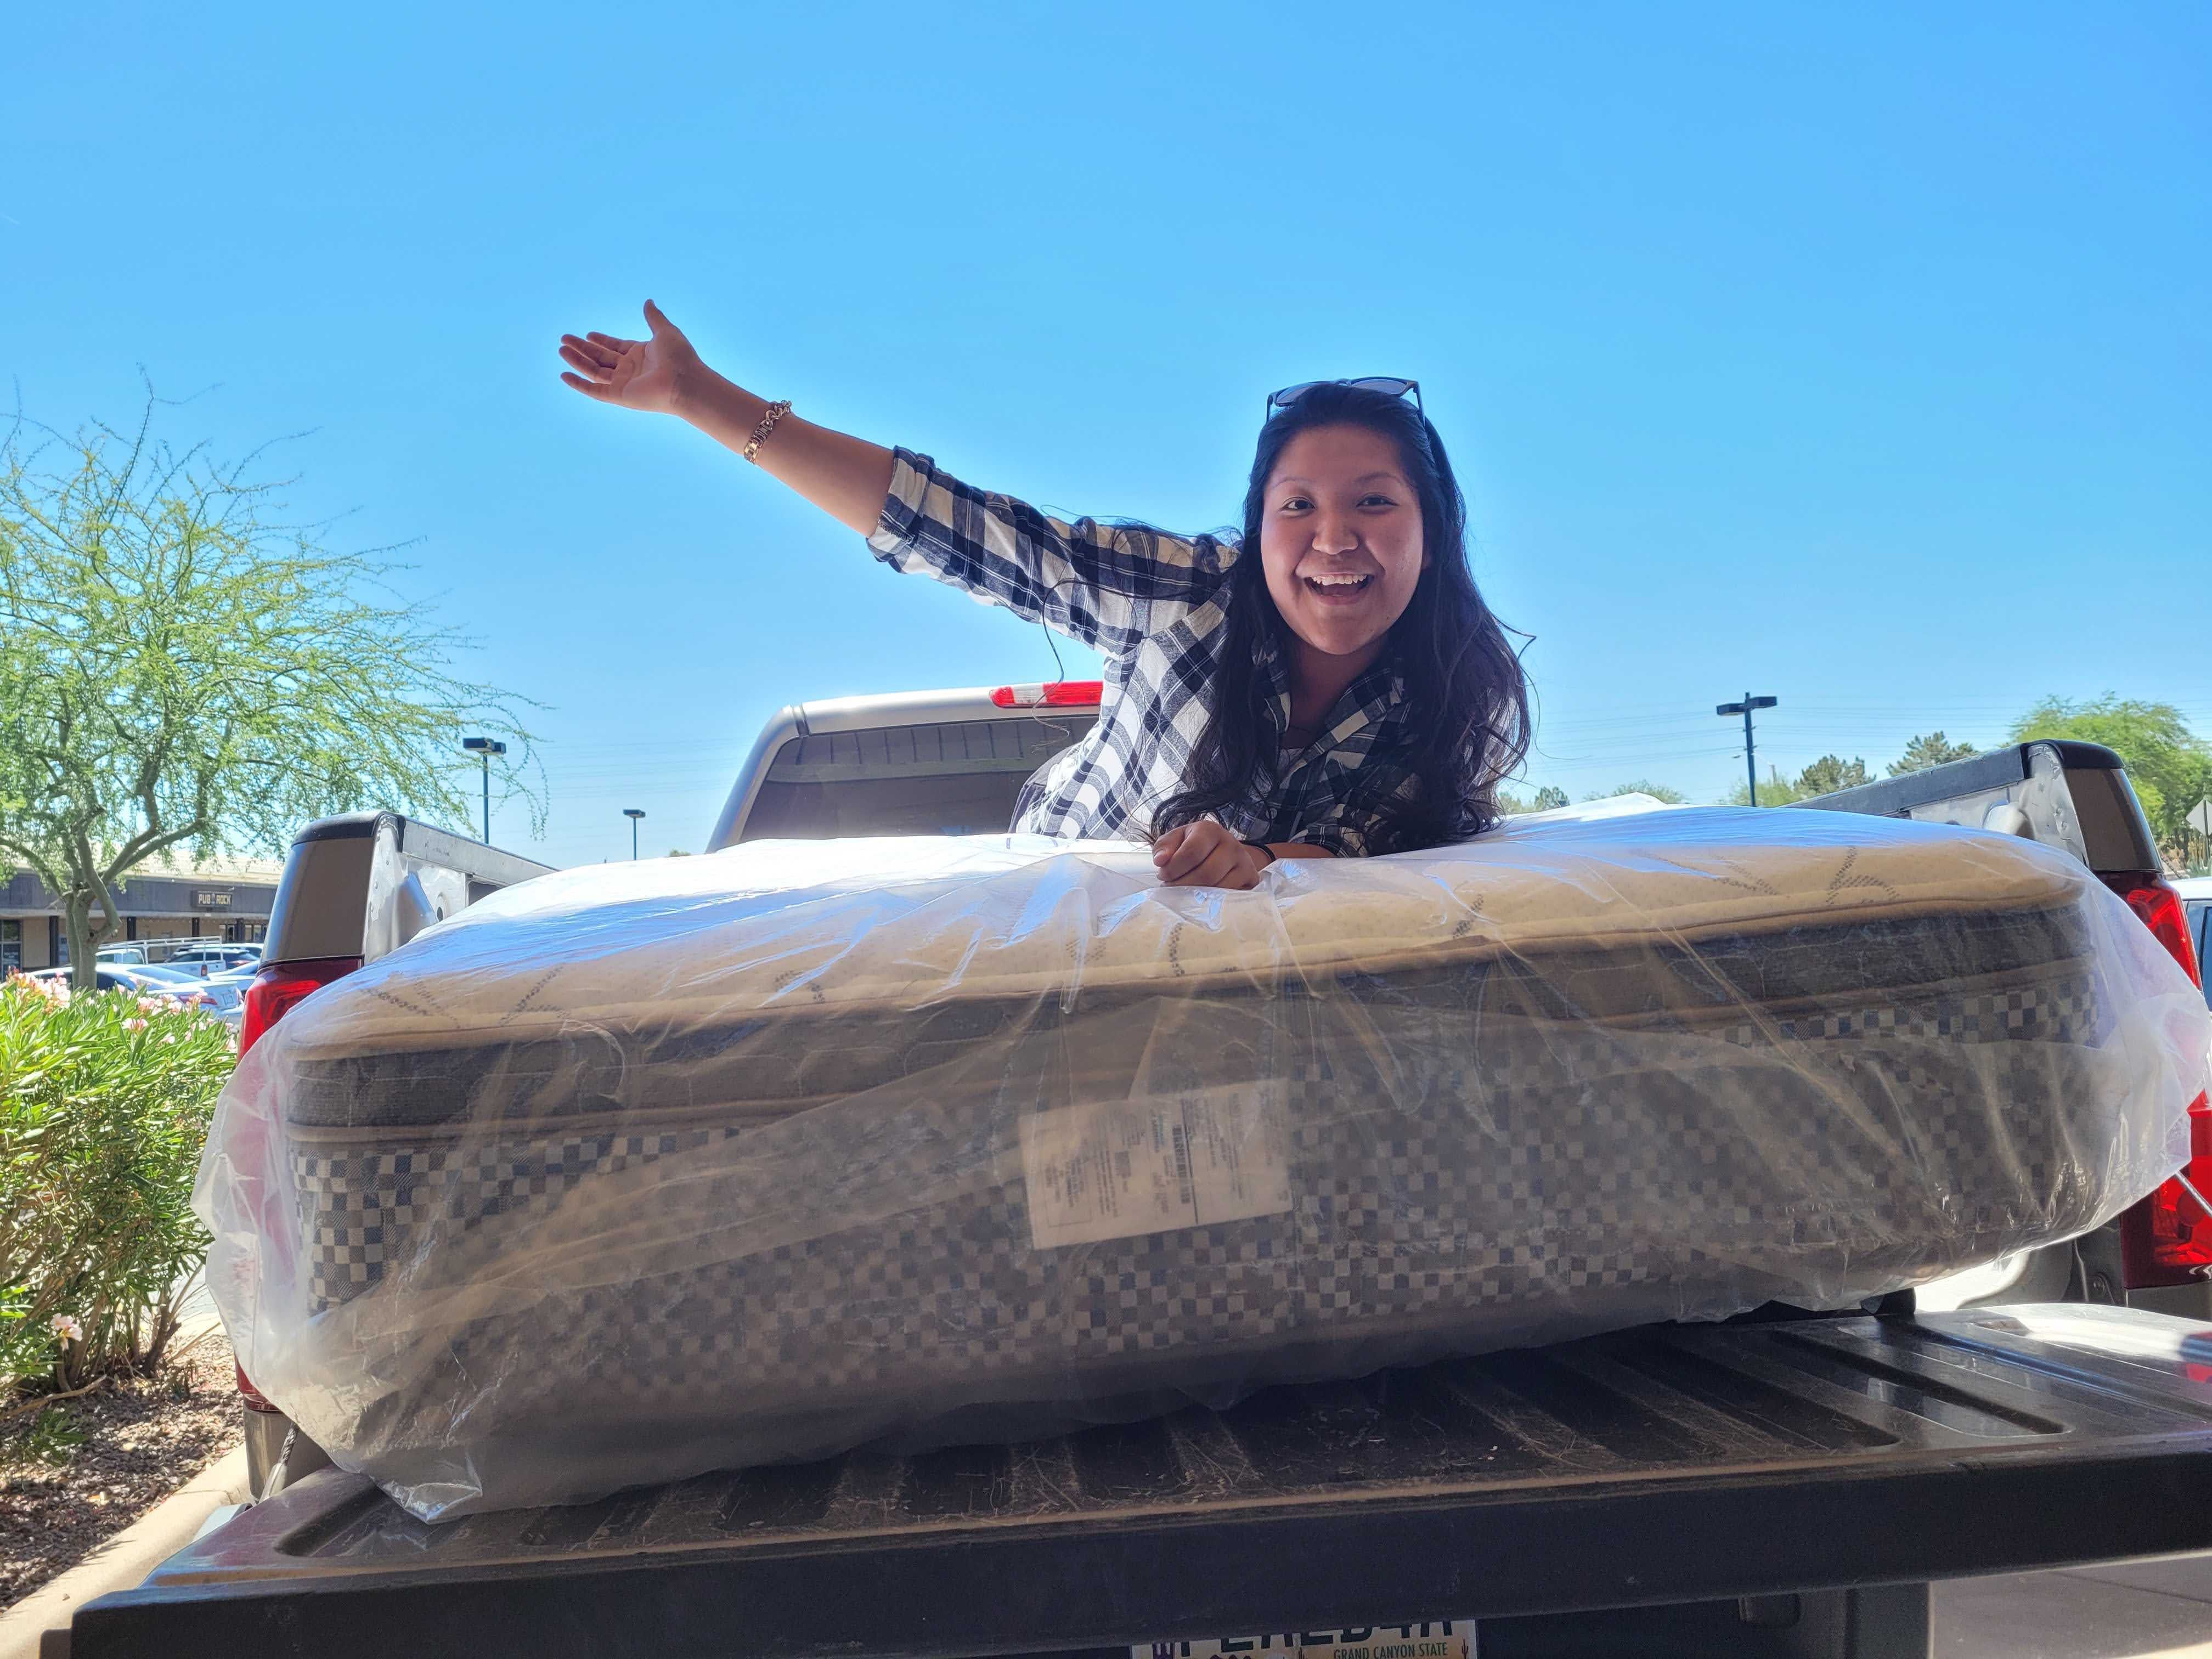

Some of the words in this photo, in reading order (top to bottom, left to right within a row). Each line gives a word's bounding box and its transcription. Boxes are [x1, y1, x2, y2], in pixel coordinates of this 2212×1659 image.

[199, 894, 211, 904] PUB
[216, 895, 231, 904] ROCK
[1334, 1647, 1370, 1659] GRAND
[1373, 1644, 1415, 1658] CANYON
[1417, 1642, 1448, 1656] STATE
